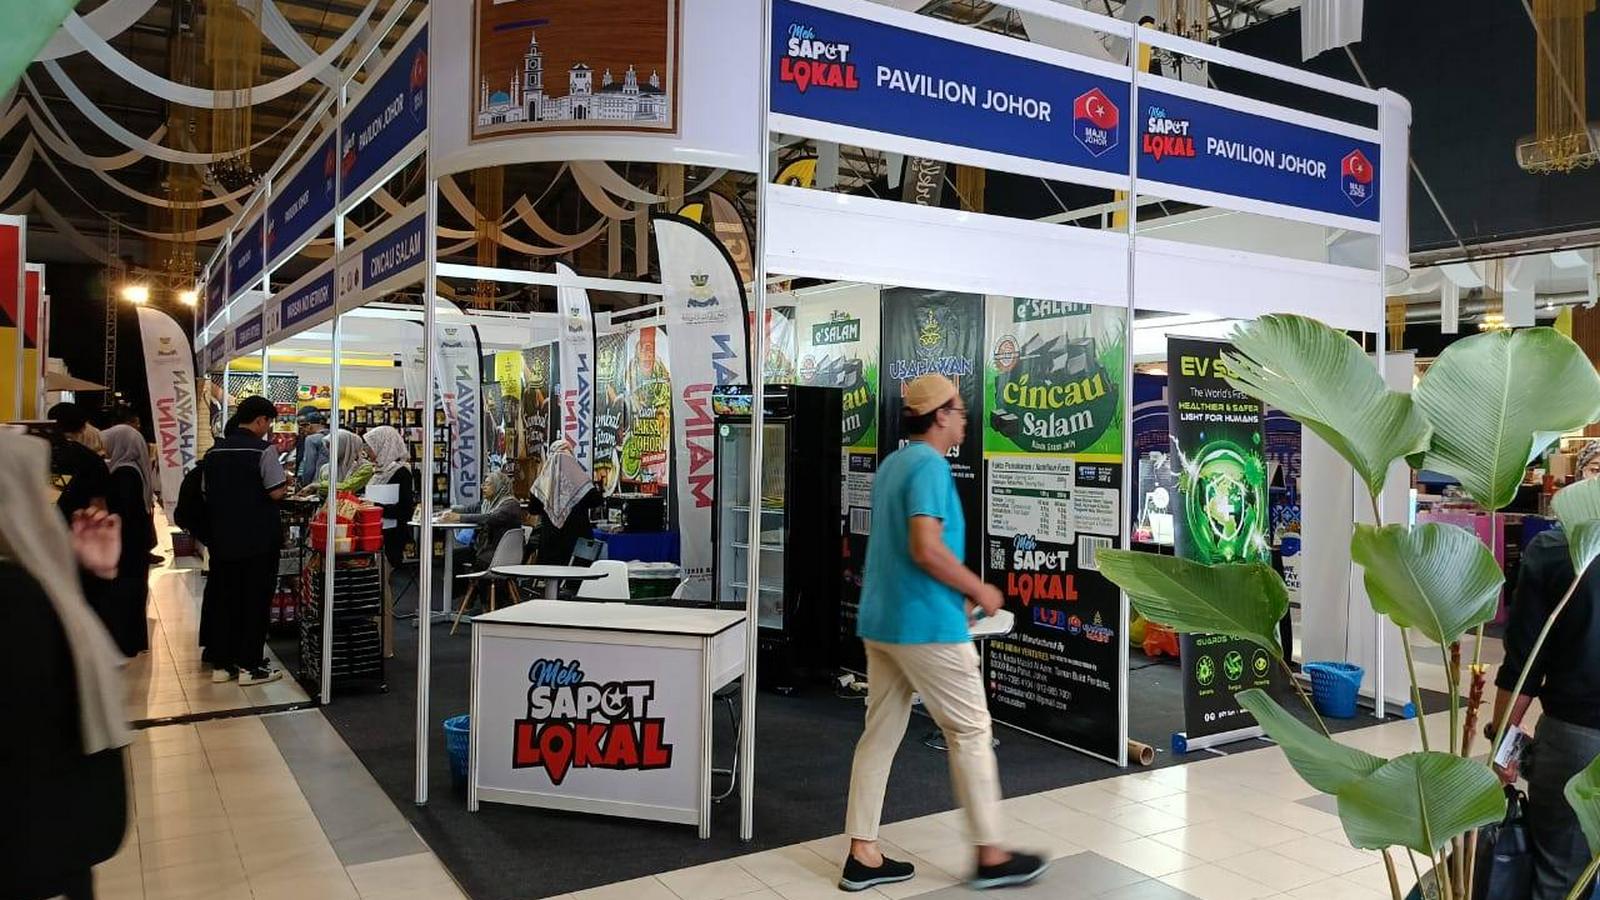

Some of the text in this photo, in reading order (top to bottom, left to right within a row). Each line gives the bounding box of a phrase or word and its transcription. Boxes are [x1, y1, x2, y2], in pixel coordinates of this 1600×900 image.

[780, 56, 858, 94] LOKAL
[876, 65, 1051, 122] PAVILION JOHOR
[1084, 126, 1107, 140] MAJU
[1084, 135, 1108, 147] JOHOR
[1143, 136, 1196, 161] LOKAL
[1206, 136, 1327, 179] PAVILION JOHOR
[1180, 356, 1210, 377] EV
[1003, 370, 1107, 410] cincau
[1190, 387, 1204, 398] The
[1205, 388, 1232, 399] World's
[1178, 400, 1225, 411] HEALTHIER
[1232, 404, 1259, 412] SAFER
[1180, 412, 1259, 424] LIGHT FOR HUMANS
[1022, 406, 1095, 439] Salam
[1007, 571, 1078, 607] LOKAL
[528, 658, 585, 686] Meh
[513, 718, 672, 785] LOKAL
